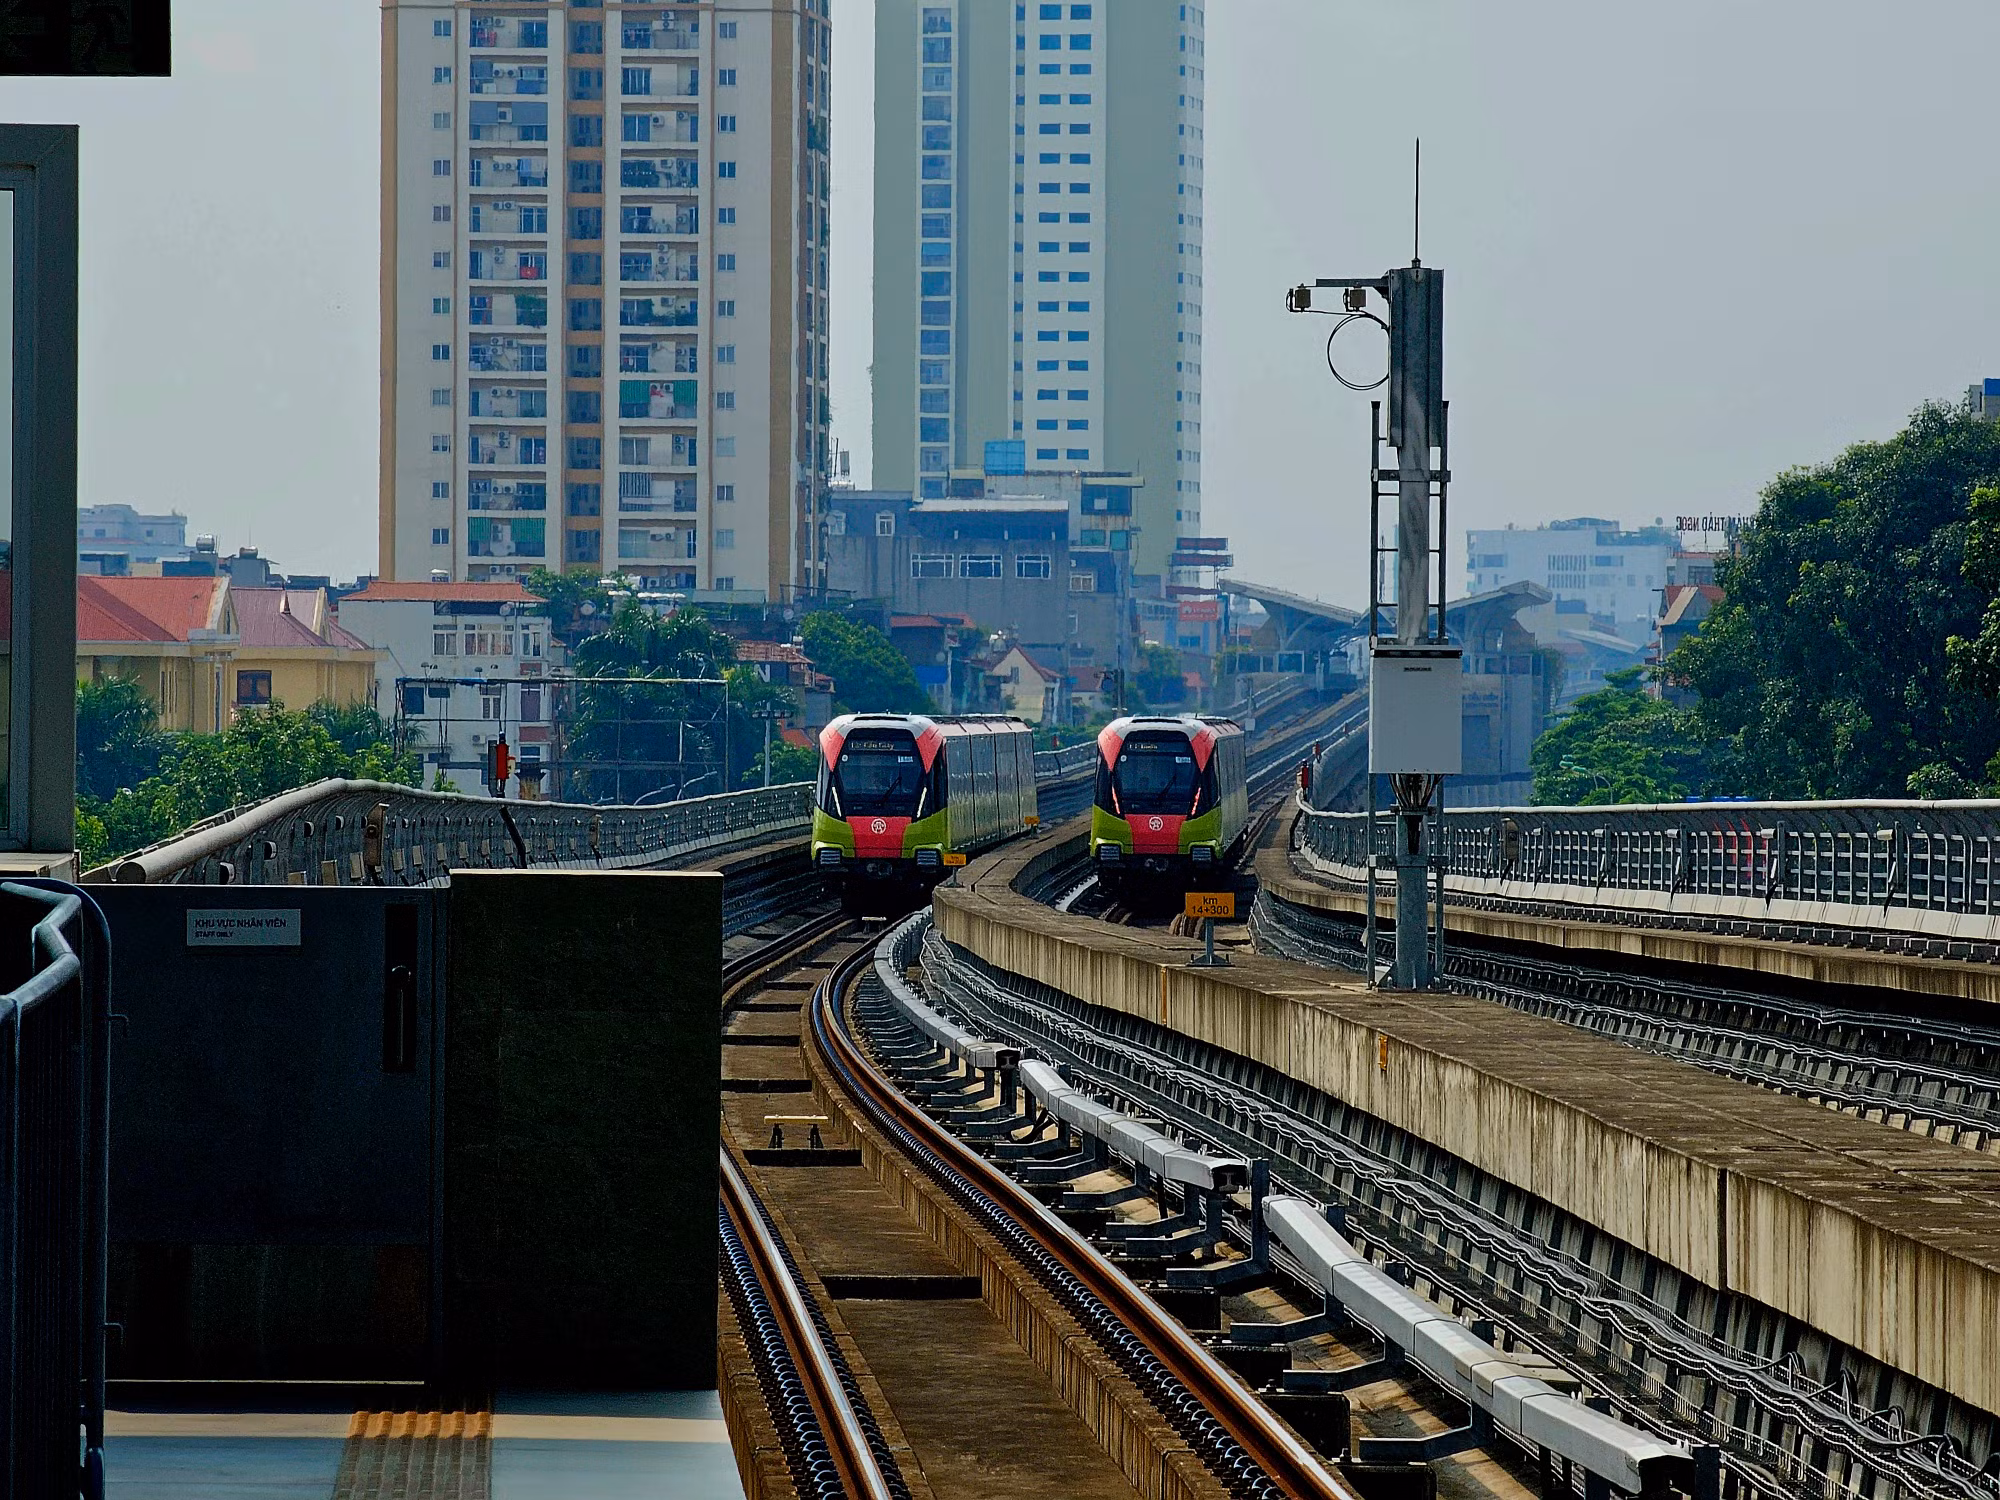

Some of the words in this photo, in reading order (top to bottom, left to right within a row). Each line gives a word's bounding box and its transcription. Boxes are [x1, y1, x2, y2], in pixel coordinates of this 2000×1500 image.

[1203, 896, 1218, 905] km
[1192, 905, 1229, 915] 14+300
[195, 918, 215, 928] KHU
[217, 917, 236, 930] VỰC
[237, 917, 263, 928] NHÂN
[265, 917, 287, 928] VIÊN
